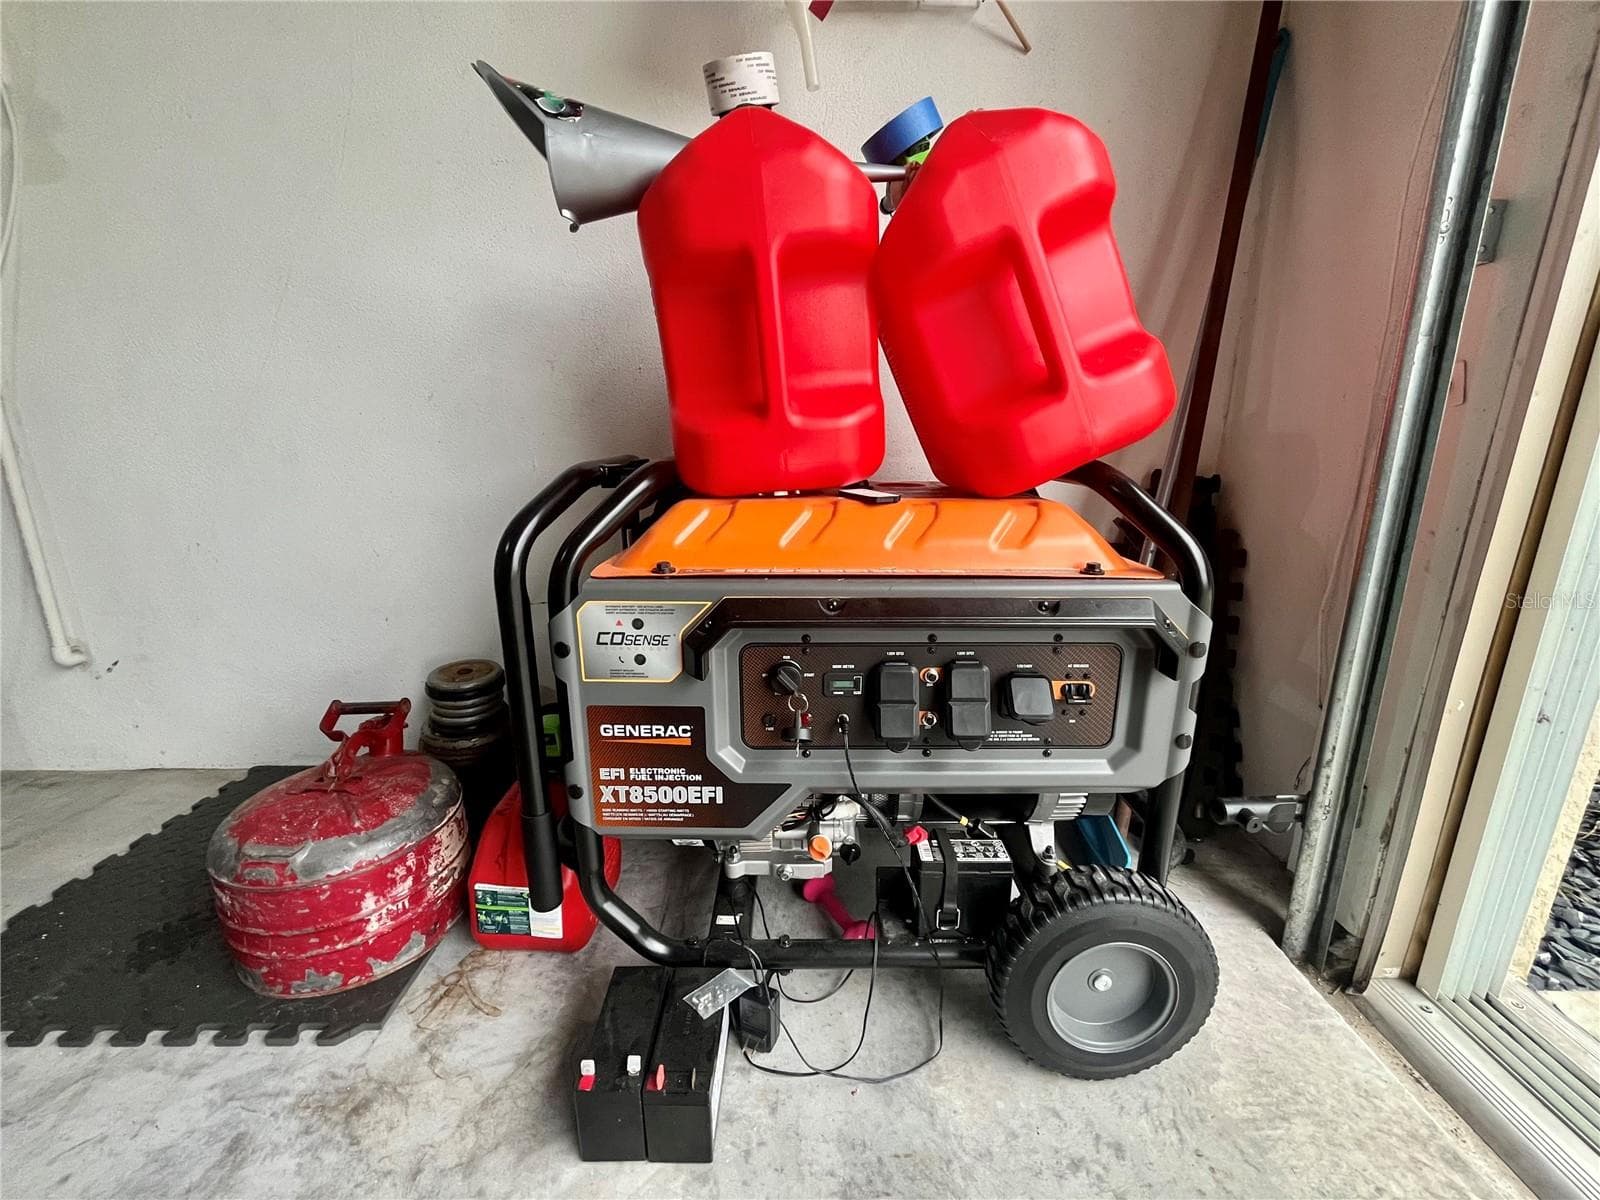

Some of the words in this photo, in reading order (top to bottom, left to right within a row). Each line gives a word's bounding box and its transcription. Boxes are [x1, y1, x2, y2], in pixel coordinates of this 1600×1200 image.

[599, 724, 692, 737] GENERAC
[599, 767, 625, 780] EFI
[629, 767, 686, 775] ELECTRONIC
[600, 786, 724, 804] XT8500EFI
